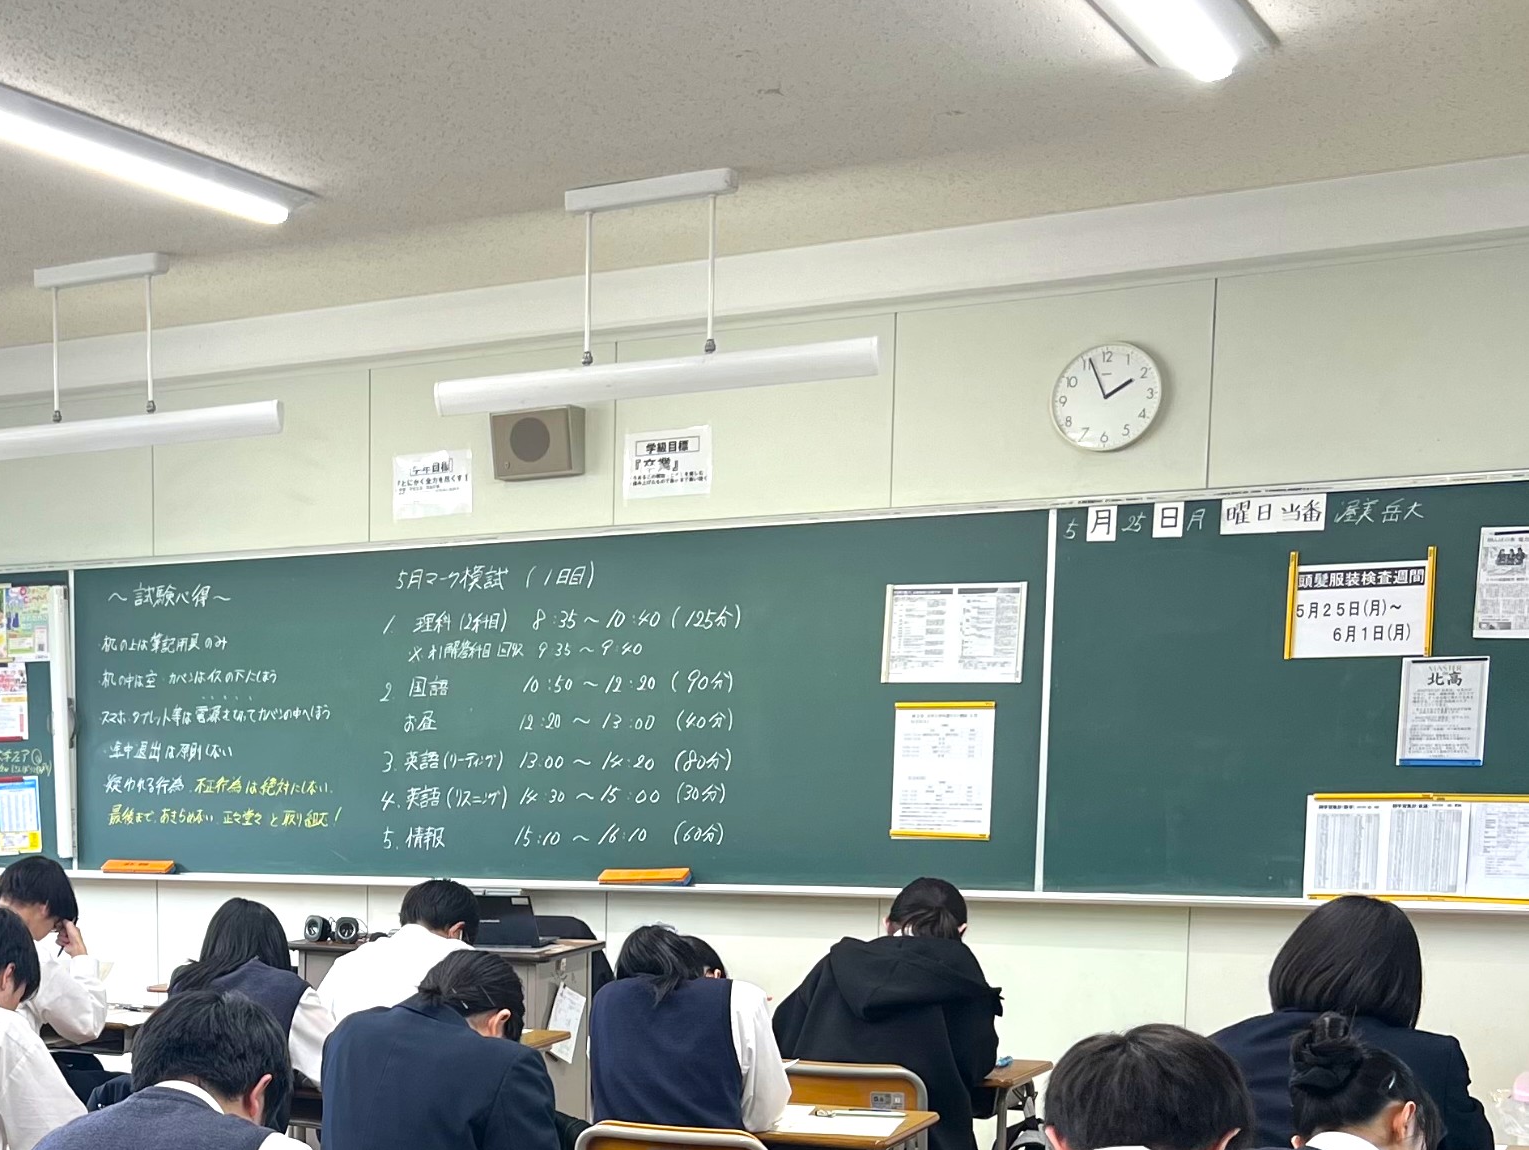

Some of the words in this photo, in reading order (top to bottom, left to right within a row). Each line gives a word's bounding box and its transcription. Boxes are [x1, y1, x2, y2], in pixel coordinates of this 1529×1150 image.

[1102, 351, 1113, 362] 12
[1125, 354, 1130, 365] 1
[1140, 367, 1148, 379] 2
[1066, 376, 1078, 388] 10
[1146, 388, 1154, 399] 3
[1059, 395, 1067, 407] 9
[1138, 408, 1146, 419] 4
[1065, 416, 1072, 427] 8
[1078, 427, 1090, 442] 7
[1122, 424, 1130, 436] 5
[1100, 432, 1108, 443] 6
[645, 440, 689, 454] 学級目標
[1063, 518, 1078, 539] 5
[1090, 509, 1112, 535] 月
[1121, 512, 1147, 533] 25
[1161, 507, 1179, 528] 日
[1186, 508, 1206, 531] 月
[396, 565, 509, 592] 5月マーク模試
[1298, 568, 1425, 589] 頭髪服装検査週間
[1427, 671, 1463, 687] 北高
[409, 675, 449, 697] 国語
[403, 710, 437, 733] お昼
[405, 825, 445, 850] 情報
